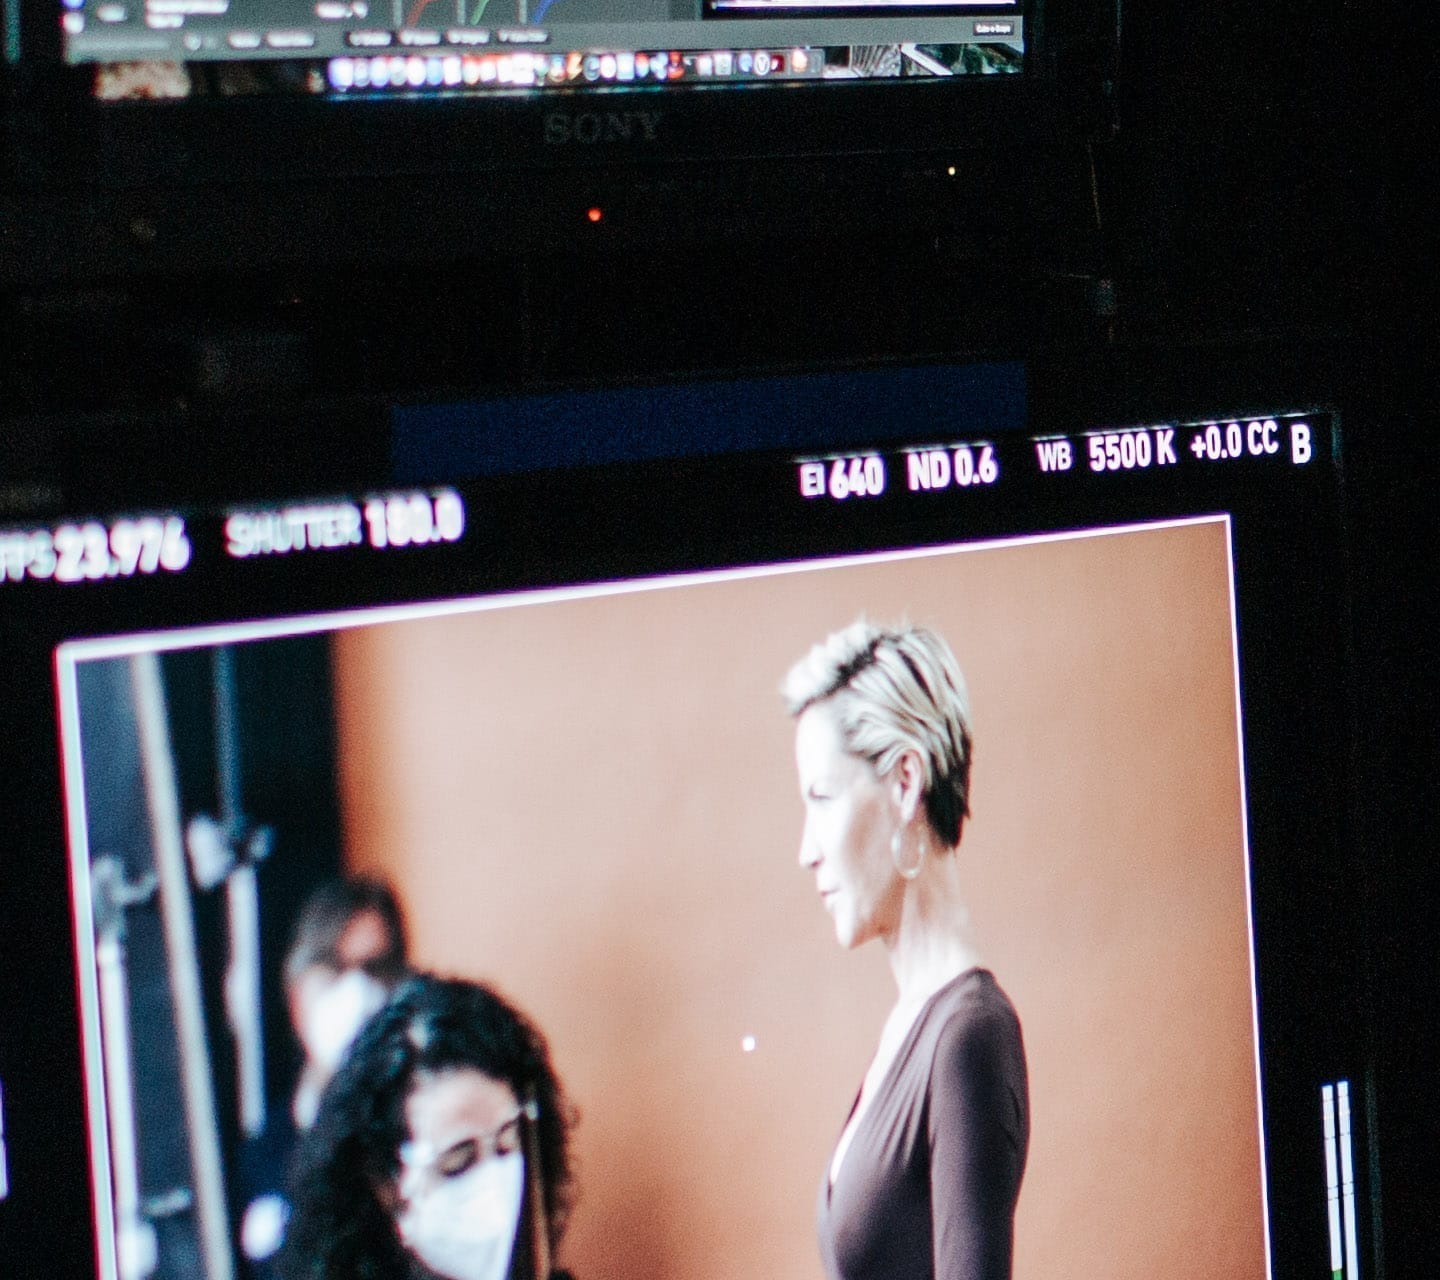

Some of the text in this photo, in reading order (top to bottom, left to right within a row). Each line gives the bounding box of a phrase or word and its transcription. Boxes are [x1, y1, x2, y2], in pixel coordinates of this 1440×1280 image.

[544, 111, 663, 146] SONY
[830, 456, 886, 500] 640
[907, 451, 951, 491] ND
[954, 445, 1000, 487] 0.6
[1038, 440, 1072, 472] WB
[1089, 431, 1152, 472] 5500
[1156, 429, 1177, 465] K
[1191, 424, 1243, 460] +0.0
[1246, 419, 1279, 456] CC
[1290, 424, 1312, 464] B
[54, 517, 191, 582] 23.976
[225, 506, 362, 557] SHUTTER
